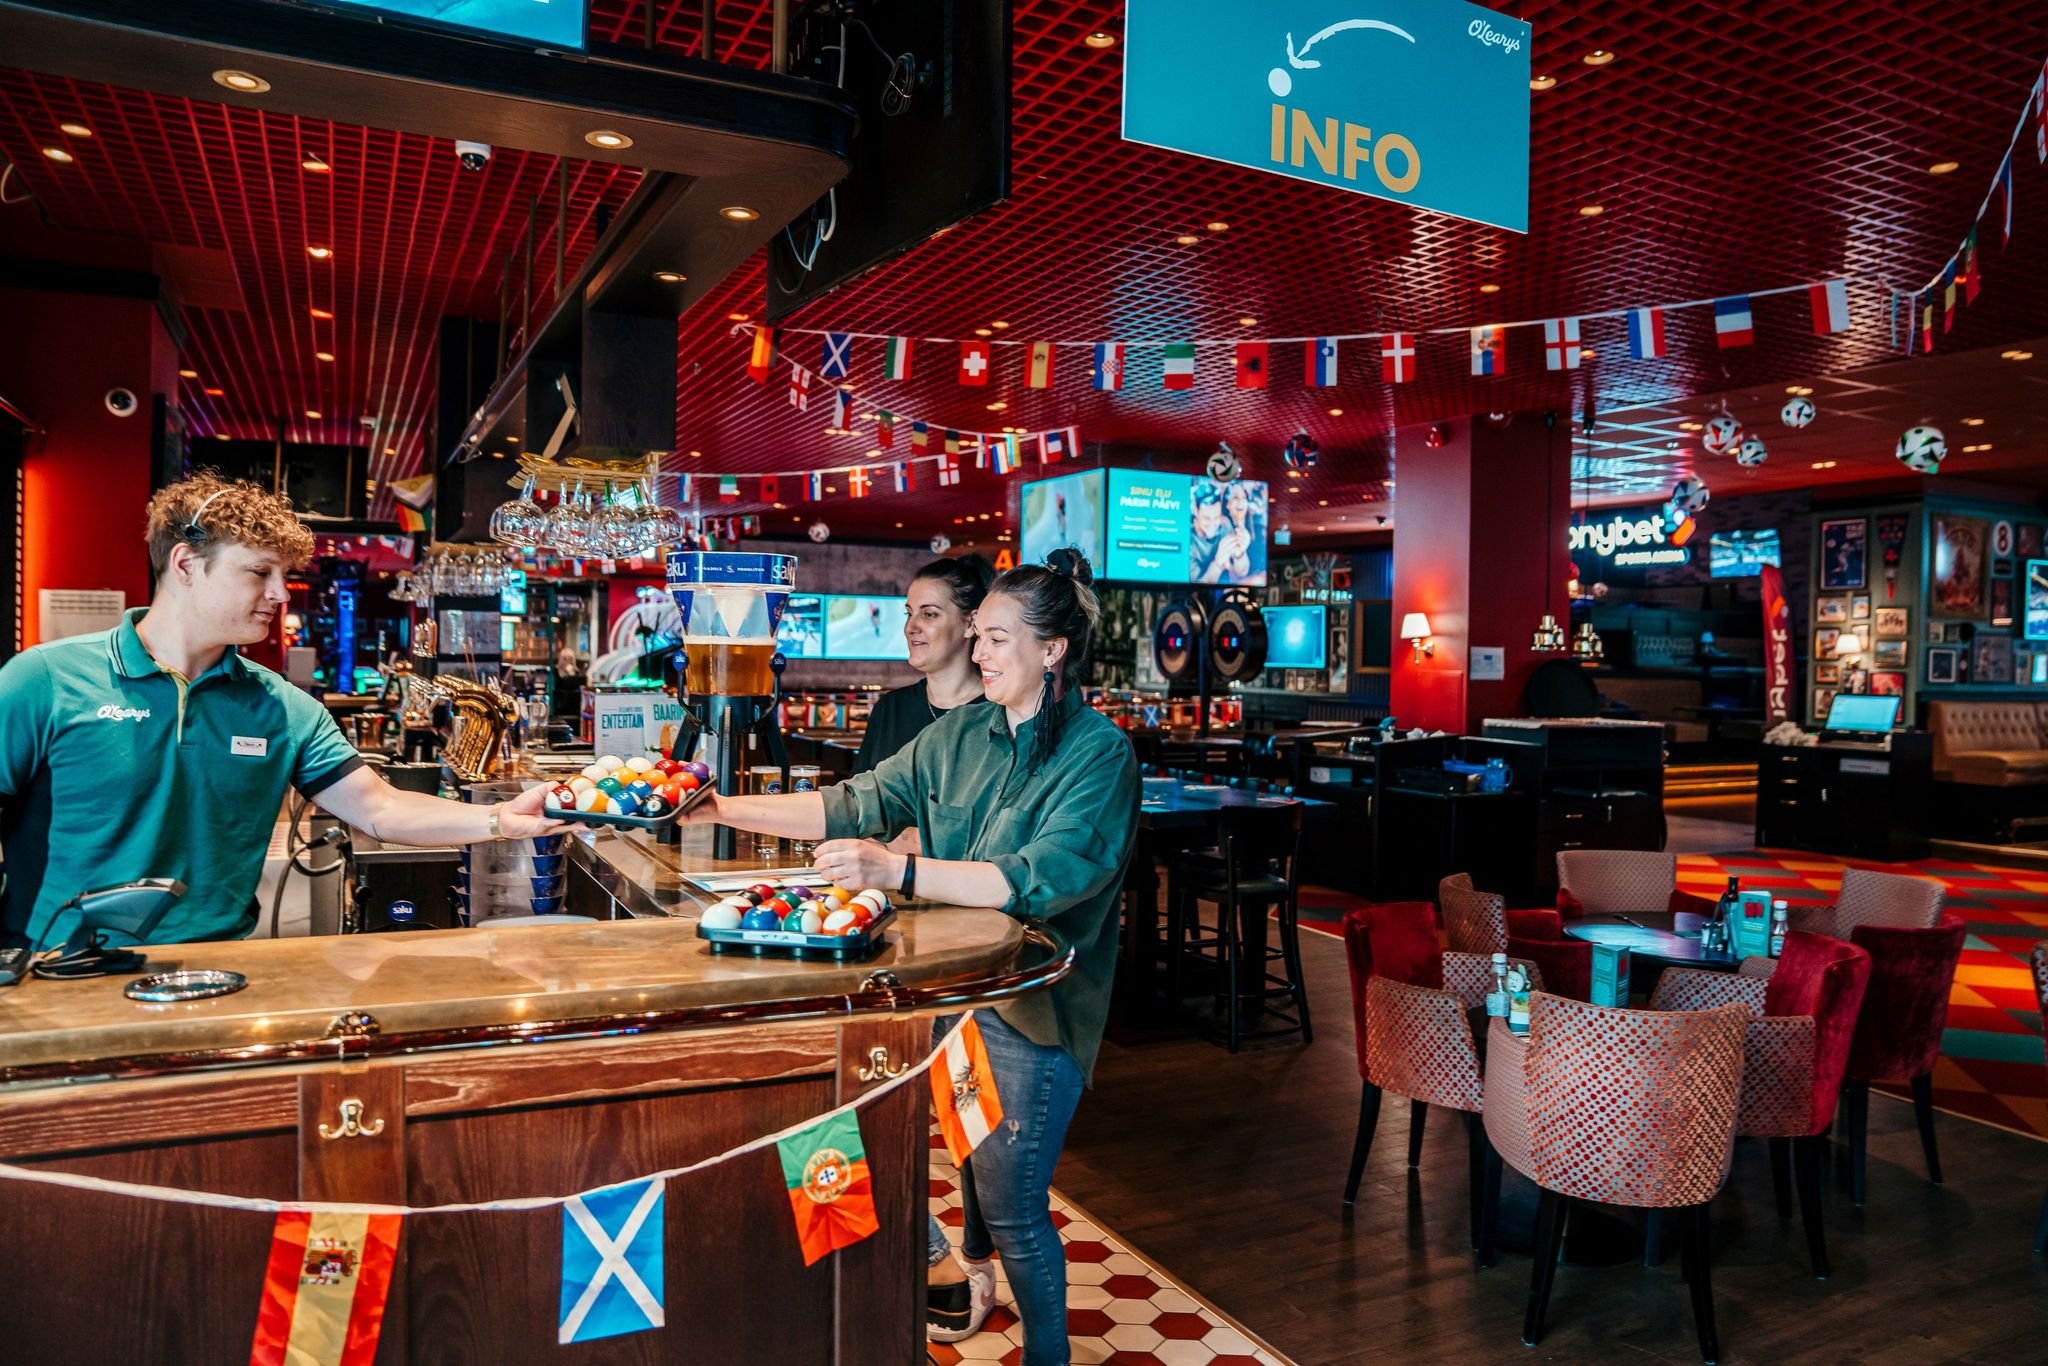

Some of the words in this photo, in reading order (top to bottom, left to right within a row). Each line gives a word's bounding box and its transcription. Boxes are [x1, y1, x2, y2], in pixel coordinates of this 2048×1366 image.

[1468, 19, 1520, 54] O'Learys
[1271, 103, 1421, 193] INFO
[97, 704, 150, 722] O'Learys
[392, 905, 413, 914] saku
